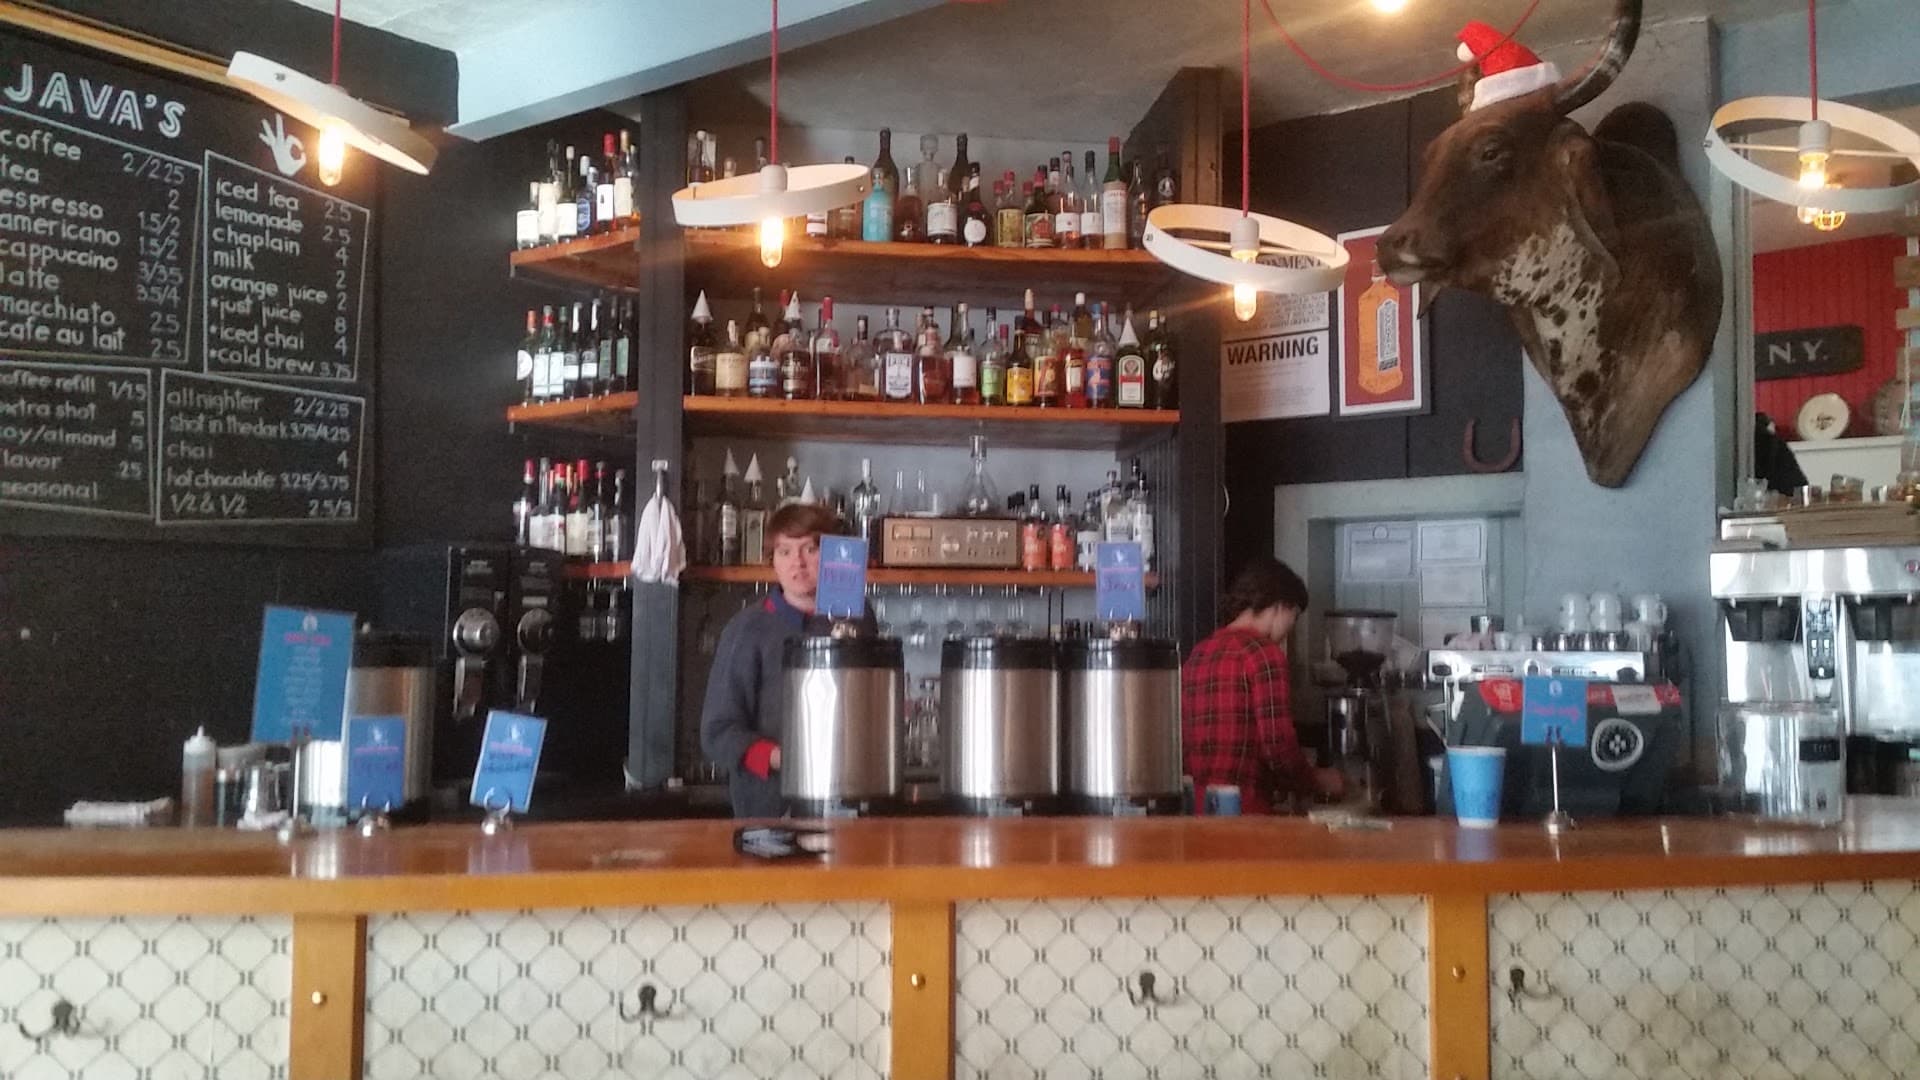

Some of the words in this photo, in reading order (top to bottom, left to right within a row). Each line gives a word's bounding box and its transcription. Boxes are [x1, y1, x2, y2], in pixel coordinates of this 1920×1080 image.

[4, 63, 186, 138] JAVA'S
[0, 129, 81, 160] coffee
[0, 154, 39, 183] tea
[168, 189, 180, 210] 2
[216, 177, 258, 202] iced
[268, 186, 299, 211] tea
[0, 188, 103, 219] espresso
[215, 198, 303, 233] lemonade
[0, 213, 120, 246] americano
[212, 224, 300, 256] chaplain
[336, 247, 349, 266] 4
[0, 238, 118, 271] cappuccino
[213, 247, 254, 270] milk
[335, 270, 347, 289] 2
[0, 262, 60, 290] latte
[211, 274, 278, 300] orange
[288, 282, 328, 307] juice
[337, 292, 347, 311] 2
[0, 295, 116, 325] macchiato
[262, 301, 302, 328] juice
[334, 316, 347, 334] 8
[0, 316, 50, 341] cafe
[56, 328, 84, 345] au
[93, 325, 126, 350] lait
[264, 325, 304, 350] chai
[334, 336, 347, 356] 4
[265, 349, 315, 373] brew
[1227, 336, 1319, 366] WARNING
[0, 369, 51, 388] offee
[56, 374, 96, 393] refill
[55, 401, 96, 421] shot
[0, 424, 117, 448] oy/almond
[167, 440, 213, 459] chai
[1, 481, 98, 500] seasonal
[166, 466, 194, 486] hot
[194, 468, 275, 489] chocolate
